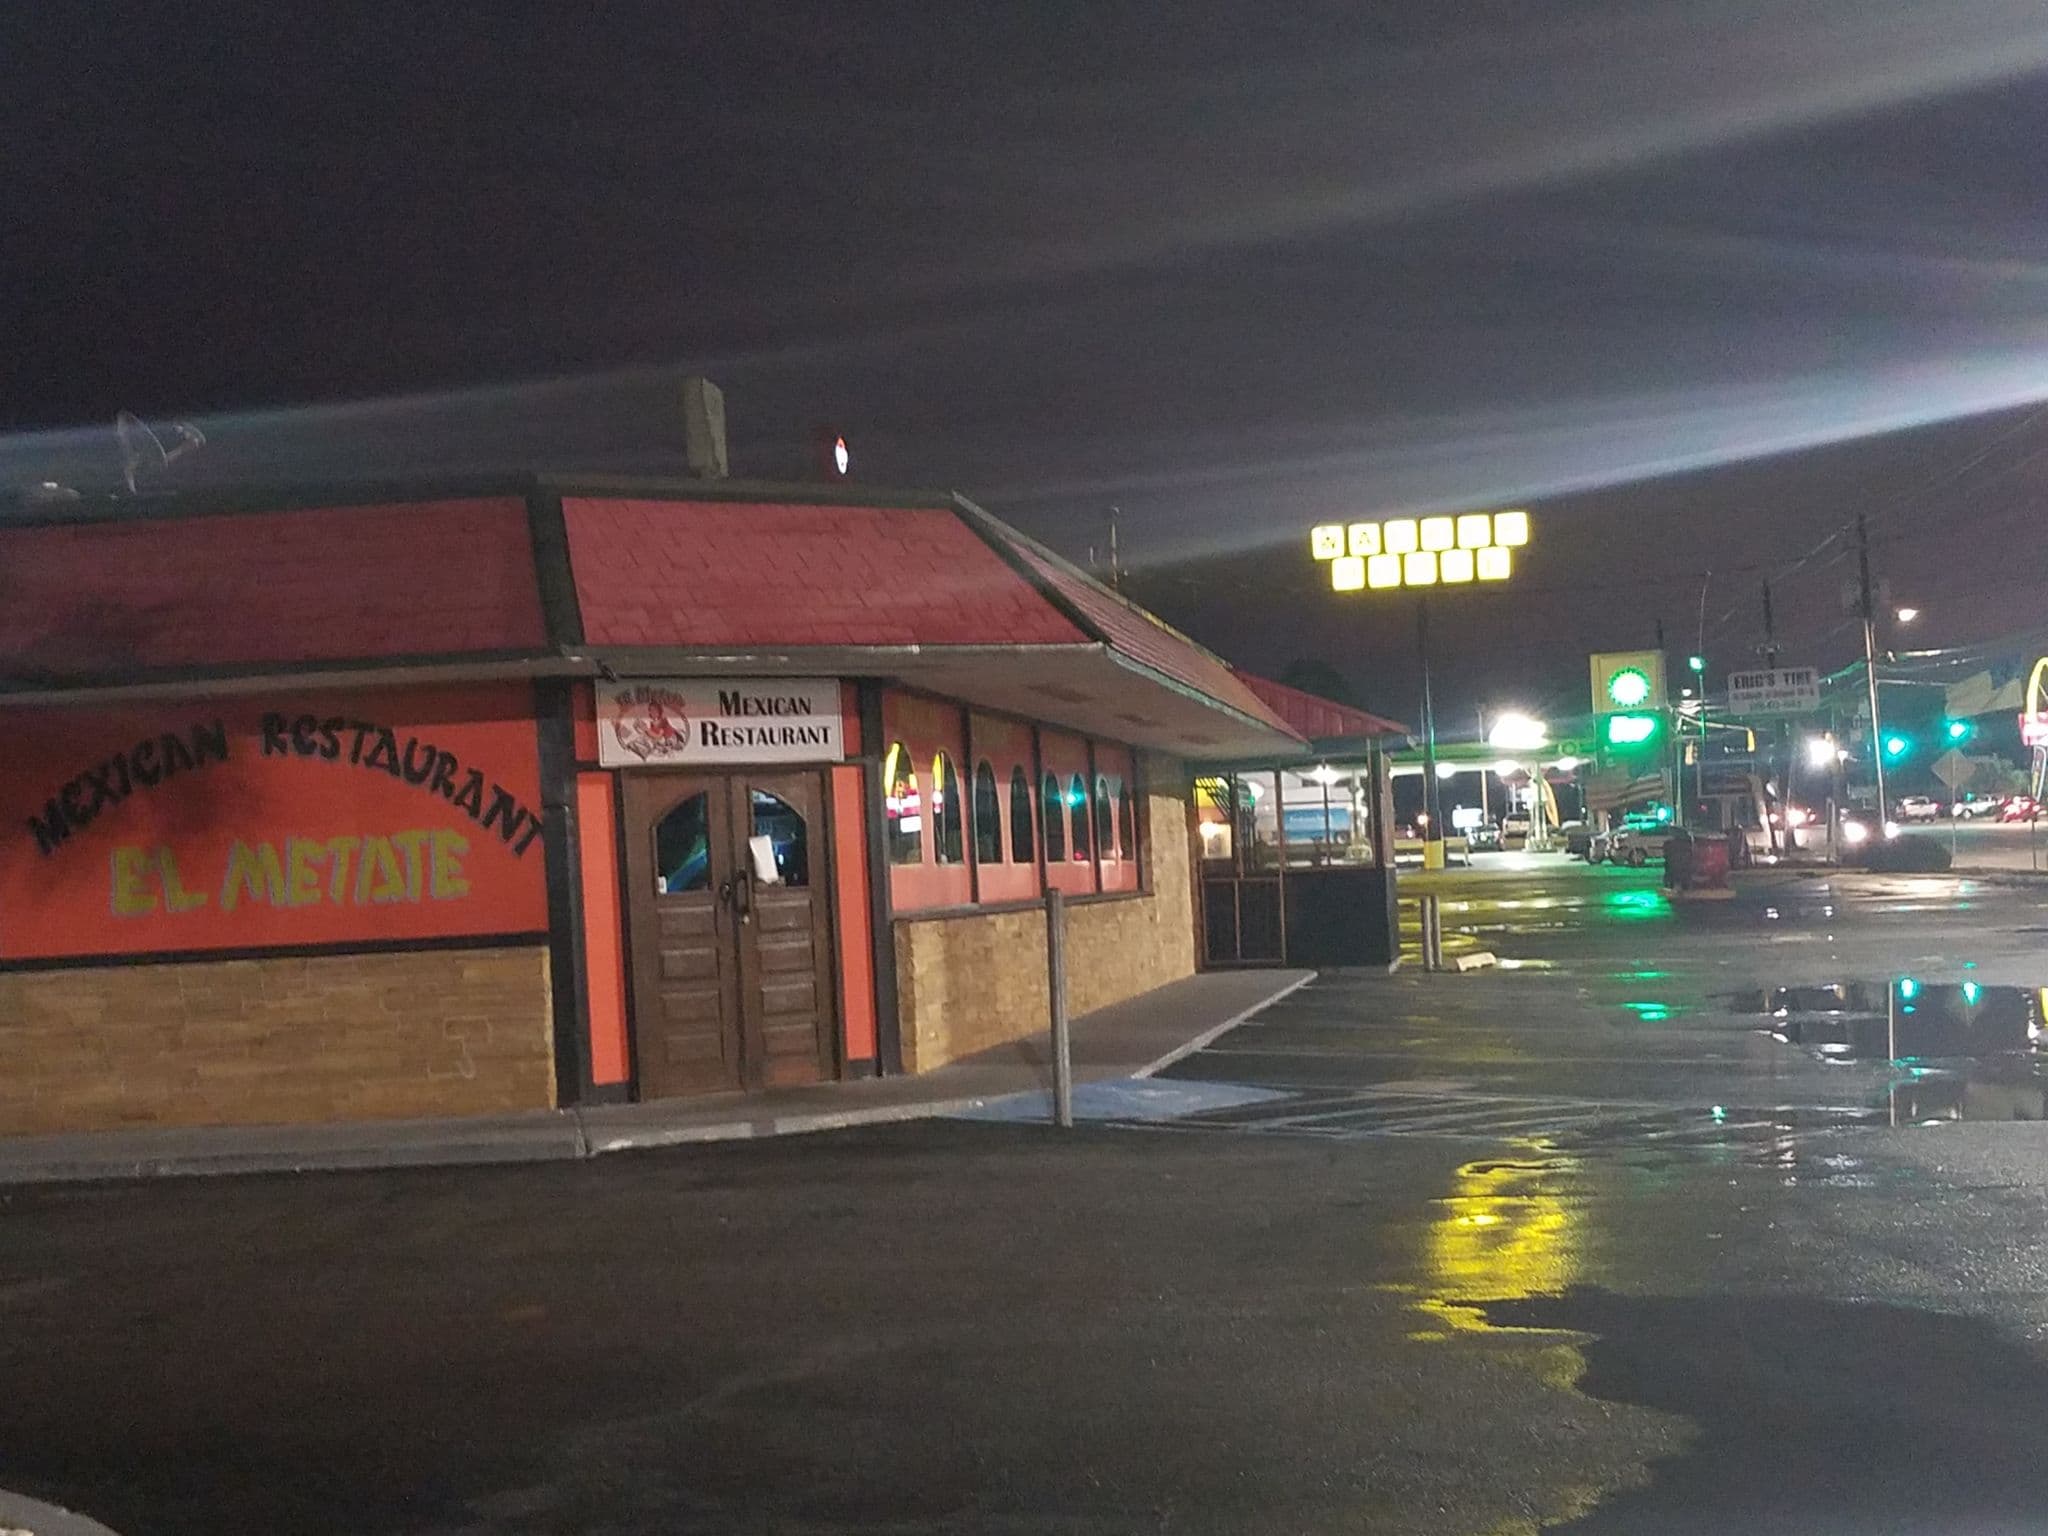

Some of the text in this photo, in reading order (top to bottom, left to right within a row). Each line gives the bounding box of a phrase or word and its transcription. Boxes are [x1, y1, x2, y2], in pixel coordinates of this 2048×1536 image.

[719, 691, 811, 716] MEXICAN
[701, 721, 831, 746] RESTAURANT
[29, 713, 545, 855] MEXICAN RESTAURANT
[111, 828, 470, 915] EL METATE
